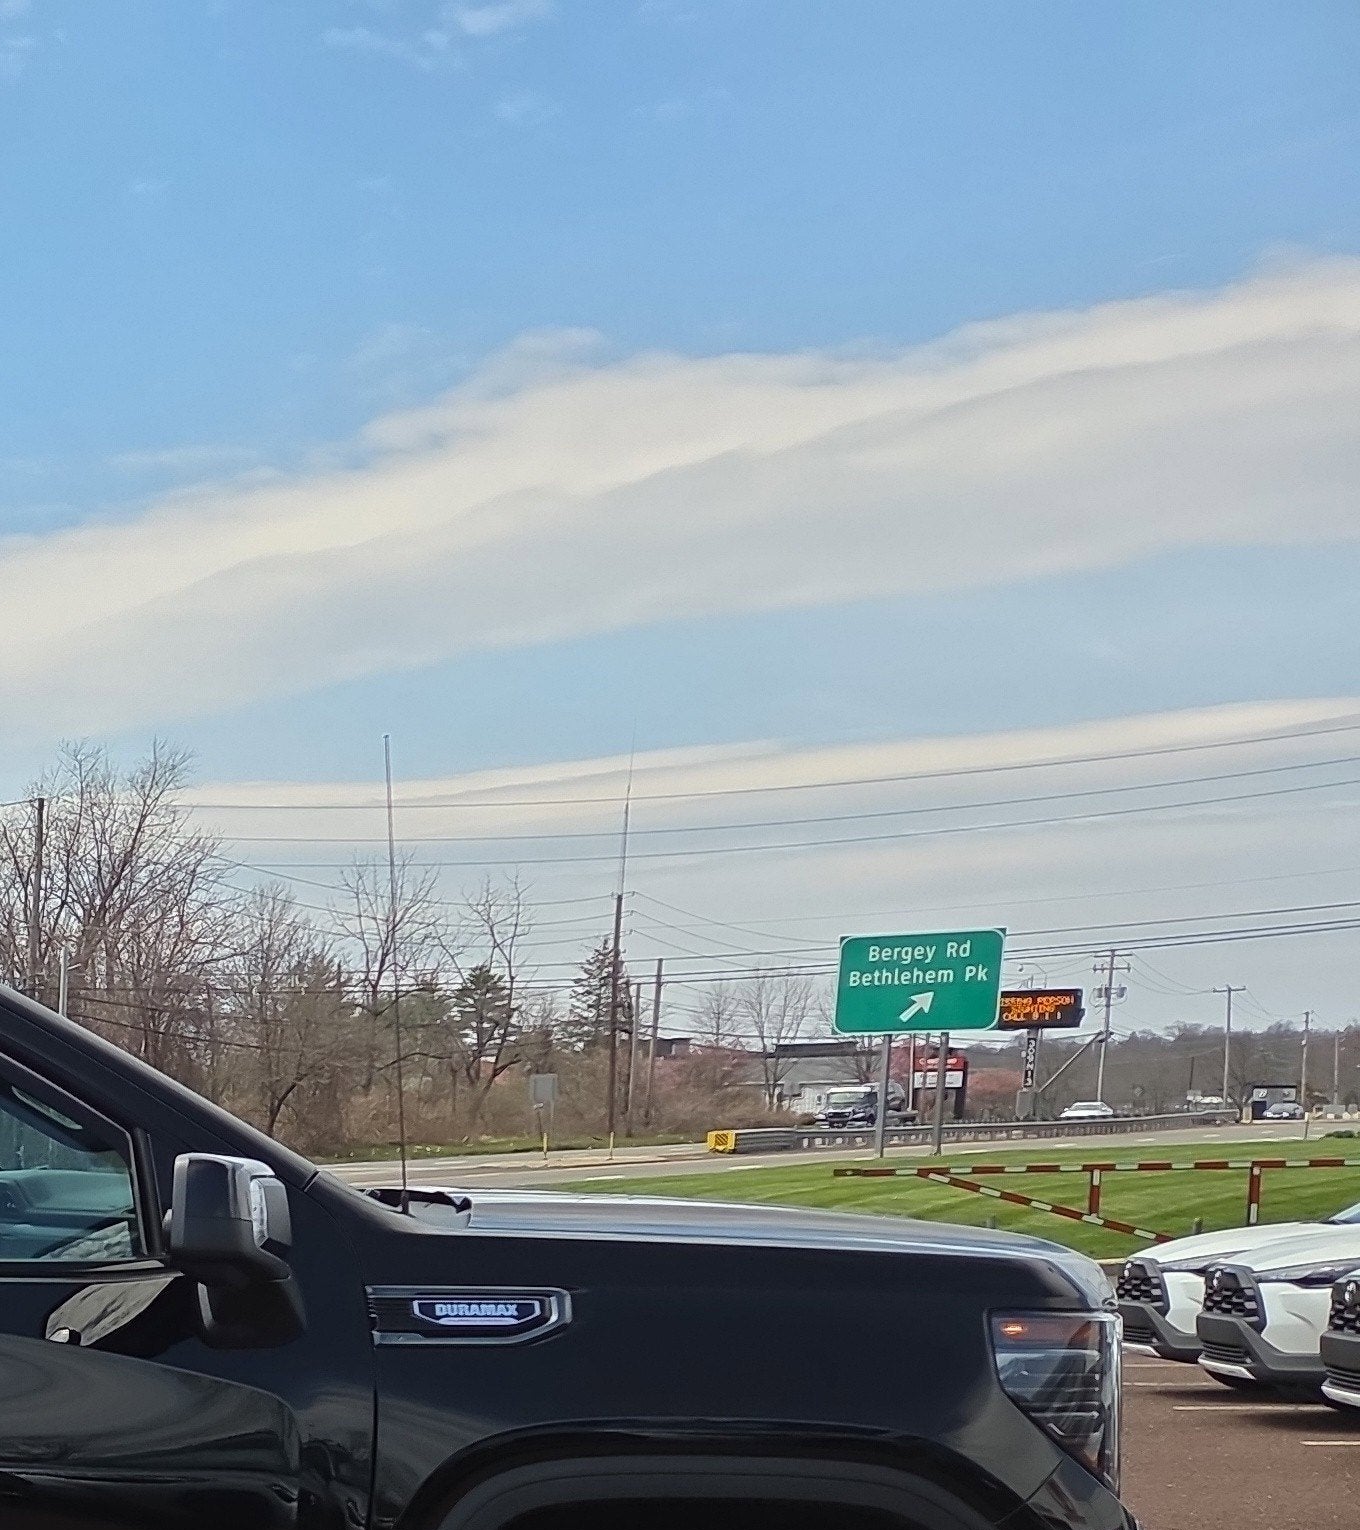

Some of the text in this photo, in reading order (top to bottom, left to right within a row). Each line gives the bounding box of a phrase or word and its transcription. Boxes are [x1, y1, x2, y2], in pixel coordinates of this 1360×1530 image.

[868, 940, 971, 965] Bergey Rd
[849, 963, 989, 987] Bethlehem Pk
[435, 1303, 518, 1317] DURAMAX
